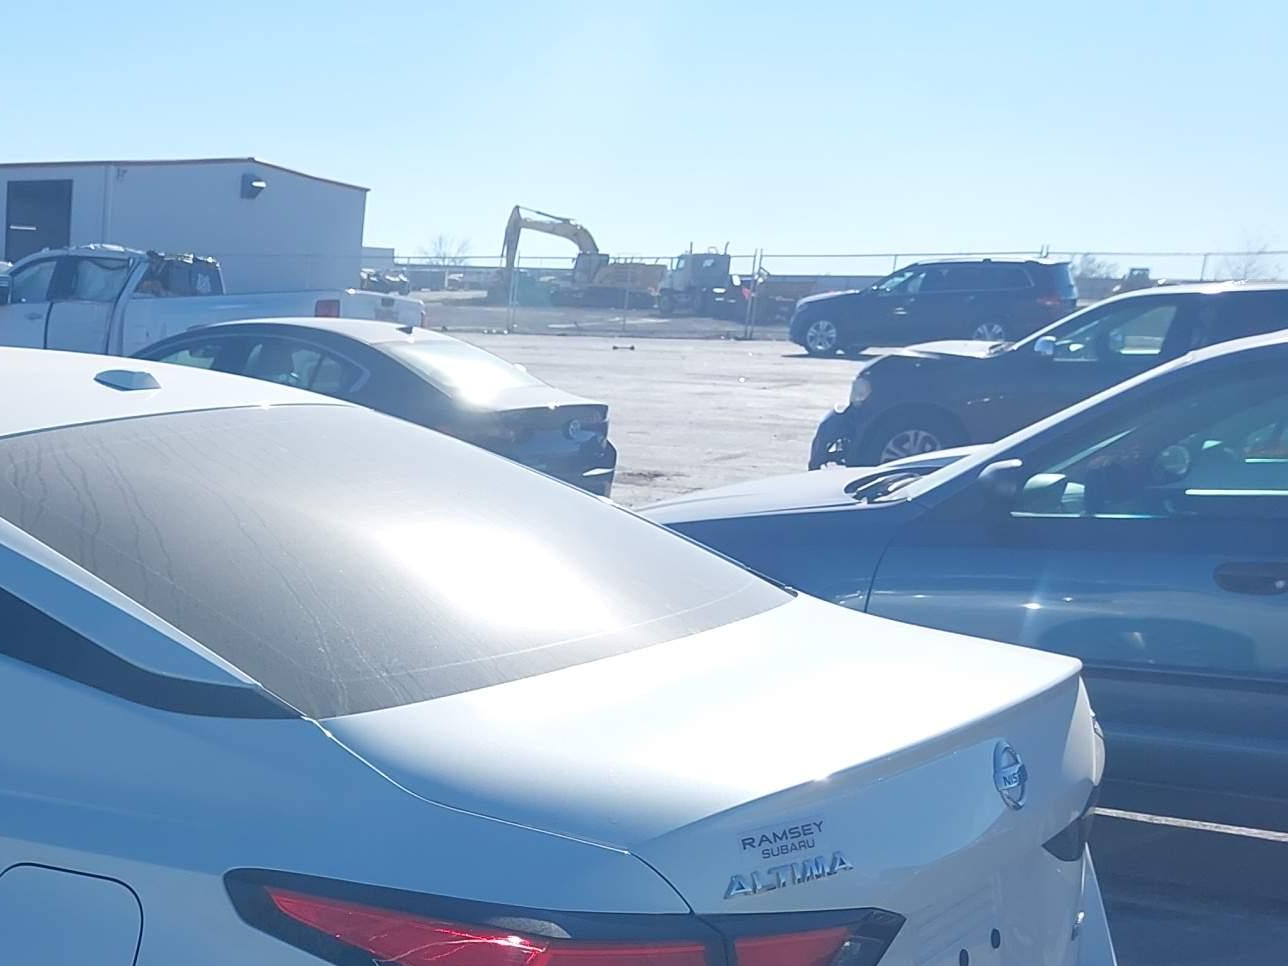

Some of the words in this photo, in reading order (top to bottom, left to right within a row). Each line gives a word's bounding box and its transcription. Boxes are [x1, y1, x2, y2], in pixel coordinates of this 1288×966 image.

[741, 820, 824, 850] RAMSEY
[761, 839, 816, 859] SUBARU
[723, 850, 854, 900] ALTIMA
